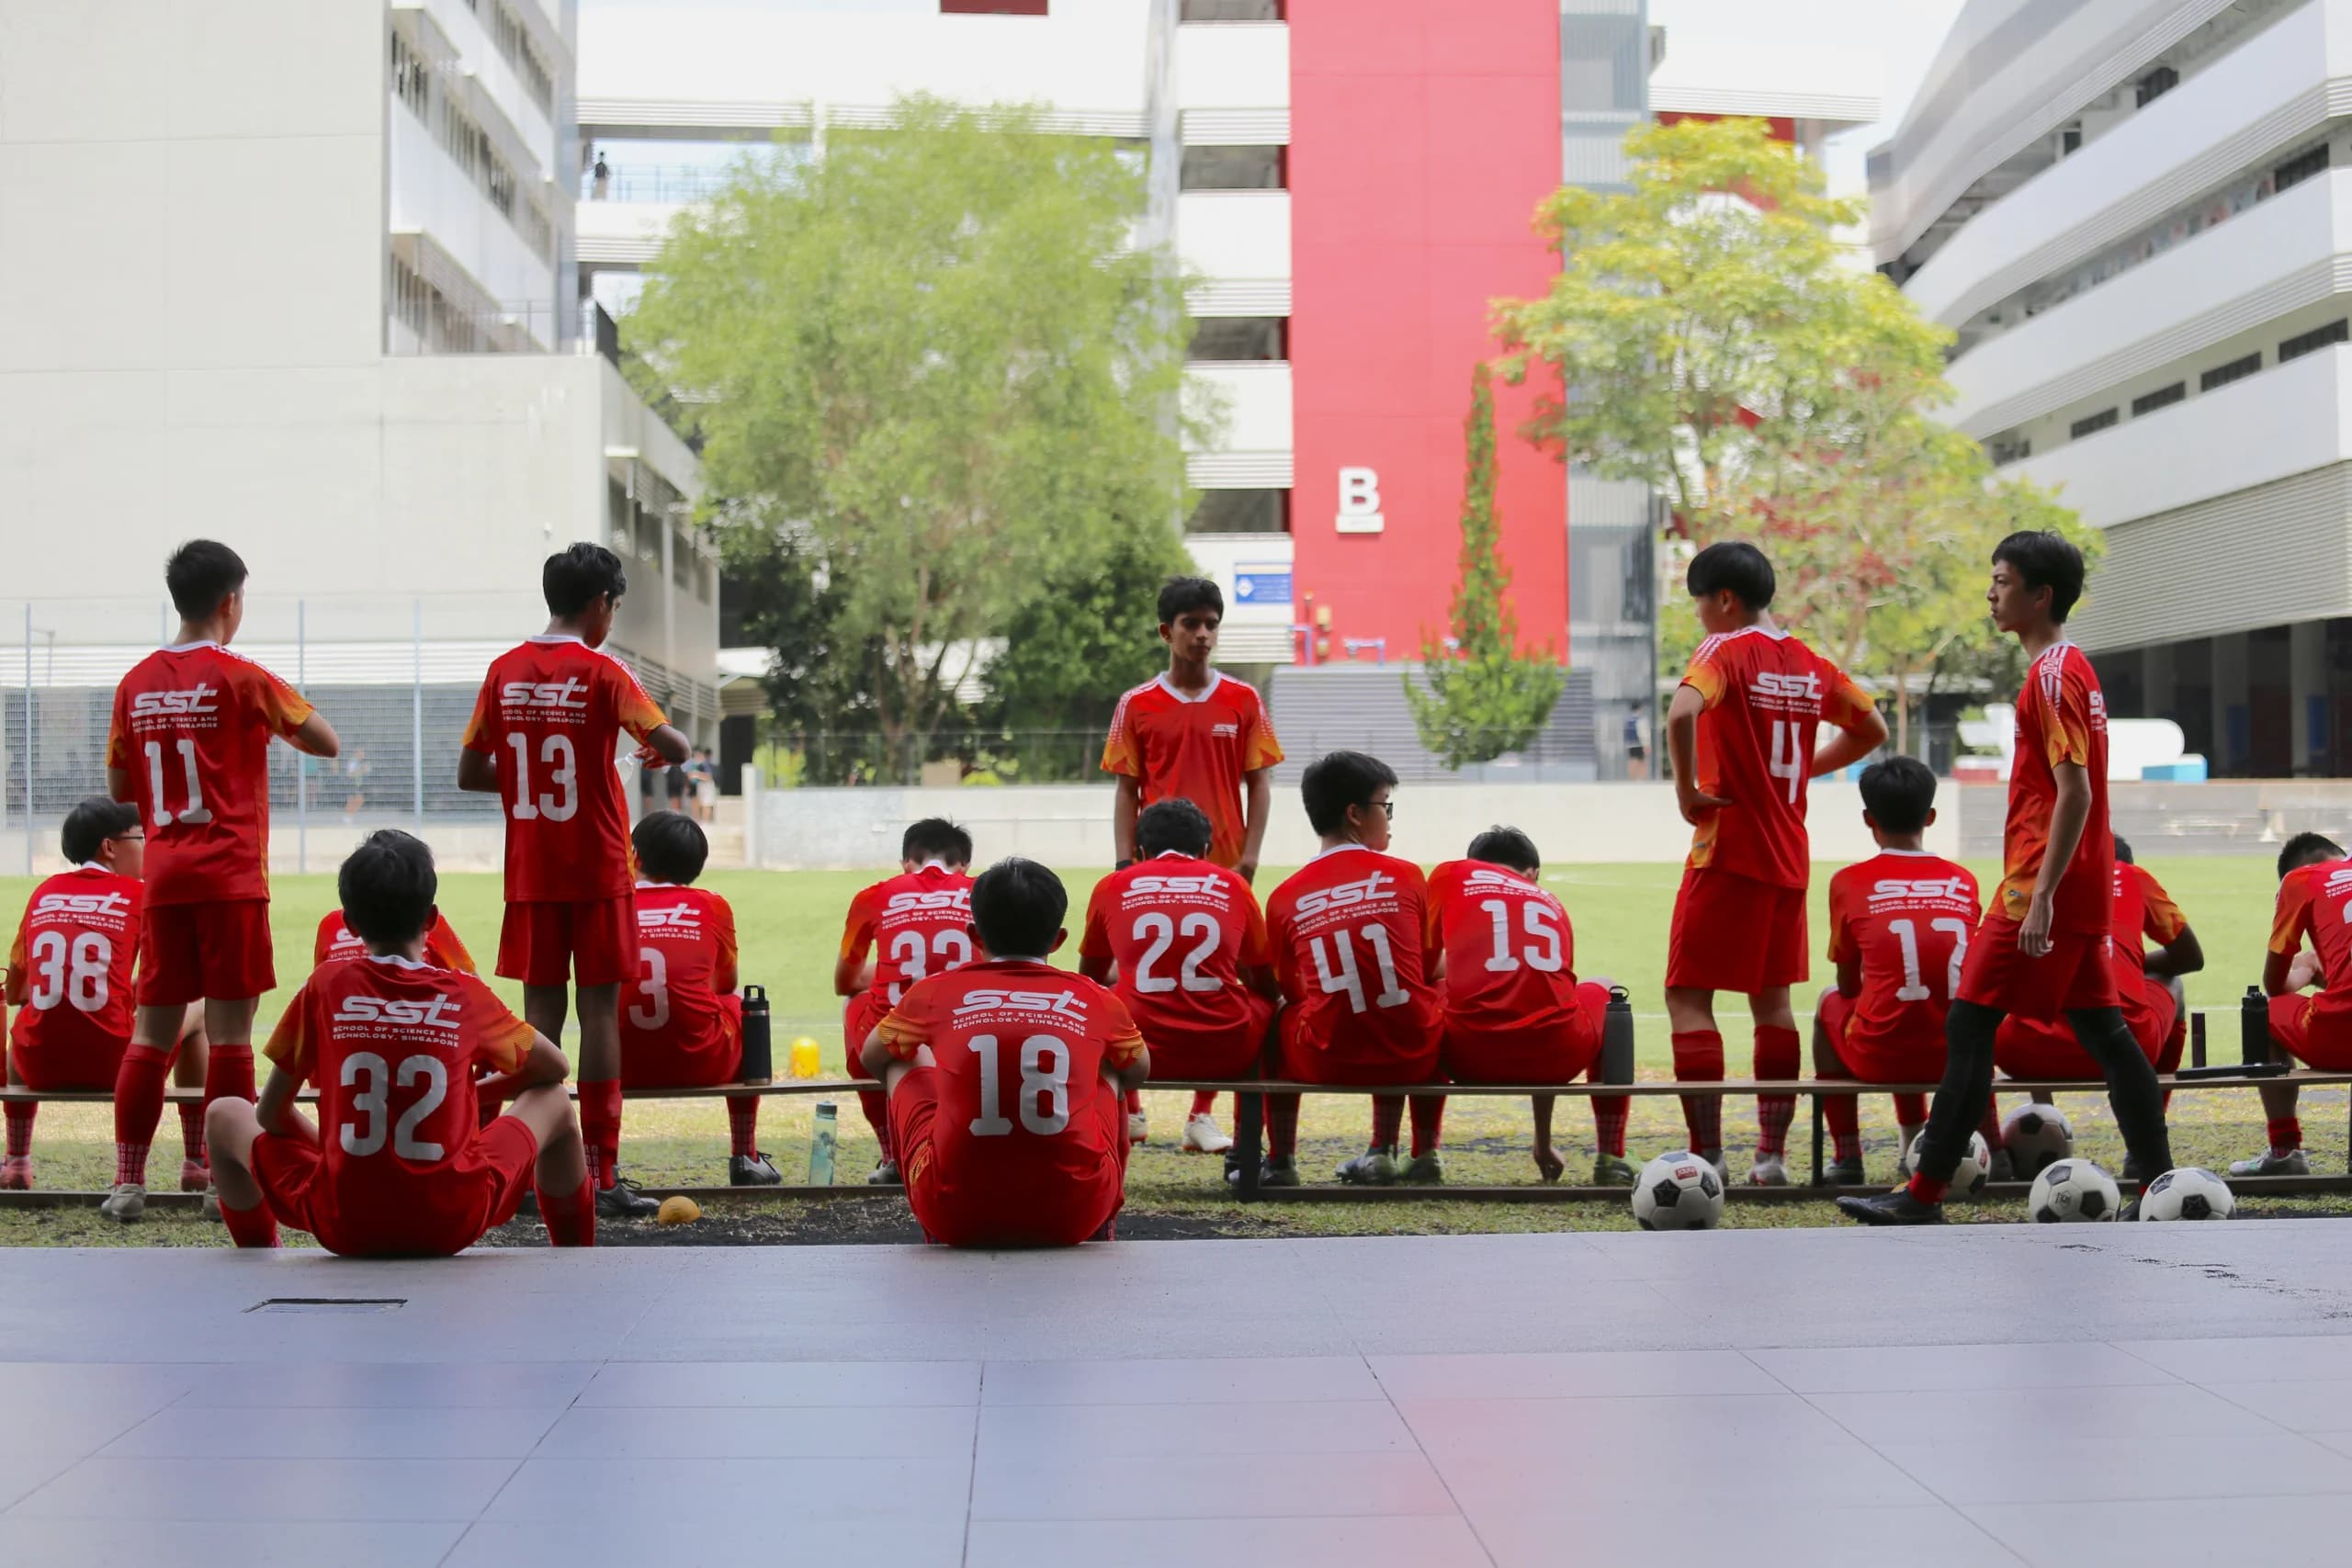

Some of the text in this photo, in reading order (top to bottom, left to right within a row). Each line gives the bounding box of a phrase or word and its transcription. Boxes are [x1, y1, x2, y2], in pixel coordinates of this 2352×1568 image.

[1339, 466, 1380, 515] B
[144, 739, 213, 827] 11
[506, 731, 578, 822] 13
[1770, 720, 1801, 804] 4
[73, 914, 106, 922] SCIENCE
[638, 903, 701, 927] st
[1343, 902, 1377, 913] SCIENCE
[1481, 899, 1563, 972] 15
[32, 931, 112, 1011] 38
[1133, 912, 1223, 993] 22
[1310, 923, 1411, 1014] 41
[1888, 918, 1968, 1001] 17
[333, 1032, 459, 1048] TECHNOLOGY, SINGAPORE
[440, 1032, 460, 1040] AND
[953, 1012, 993, 1025] SCHOOL
[1018, 1012, 1063, 1022] SCIENCE
[1068, 1020, 1086, 1032] AND
[953, 1017, 1085, 1037] TECHNOLOGY, SINGAPORE
[340, 1051, 447, 1162] 32
[967, 1034, 1070, 1136] 18
